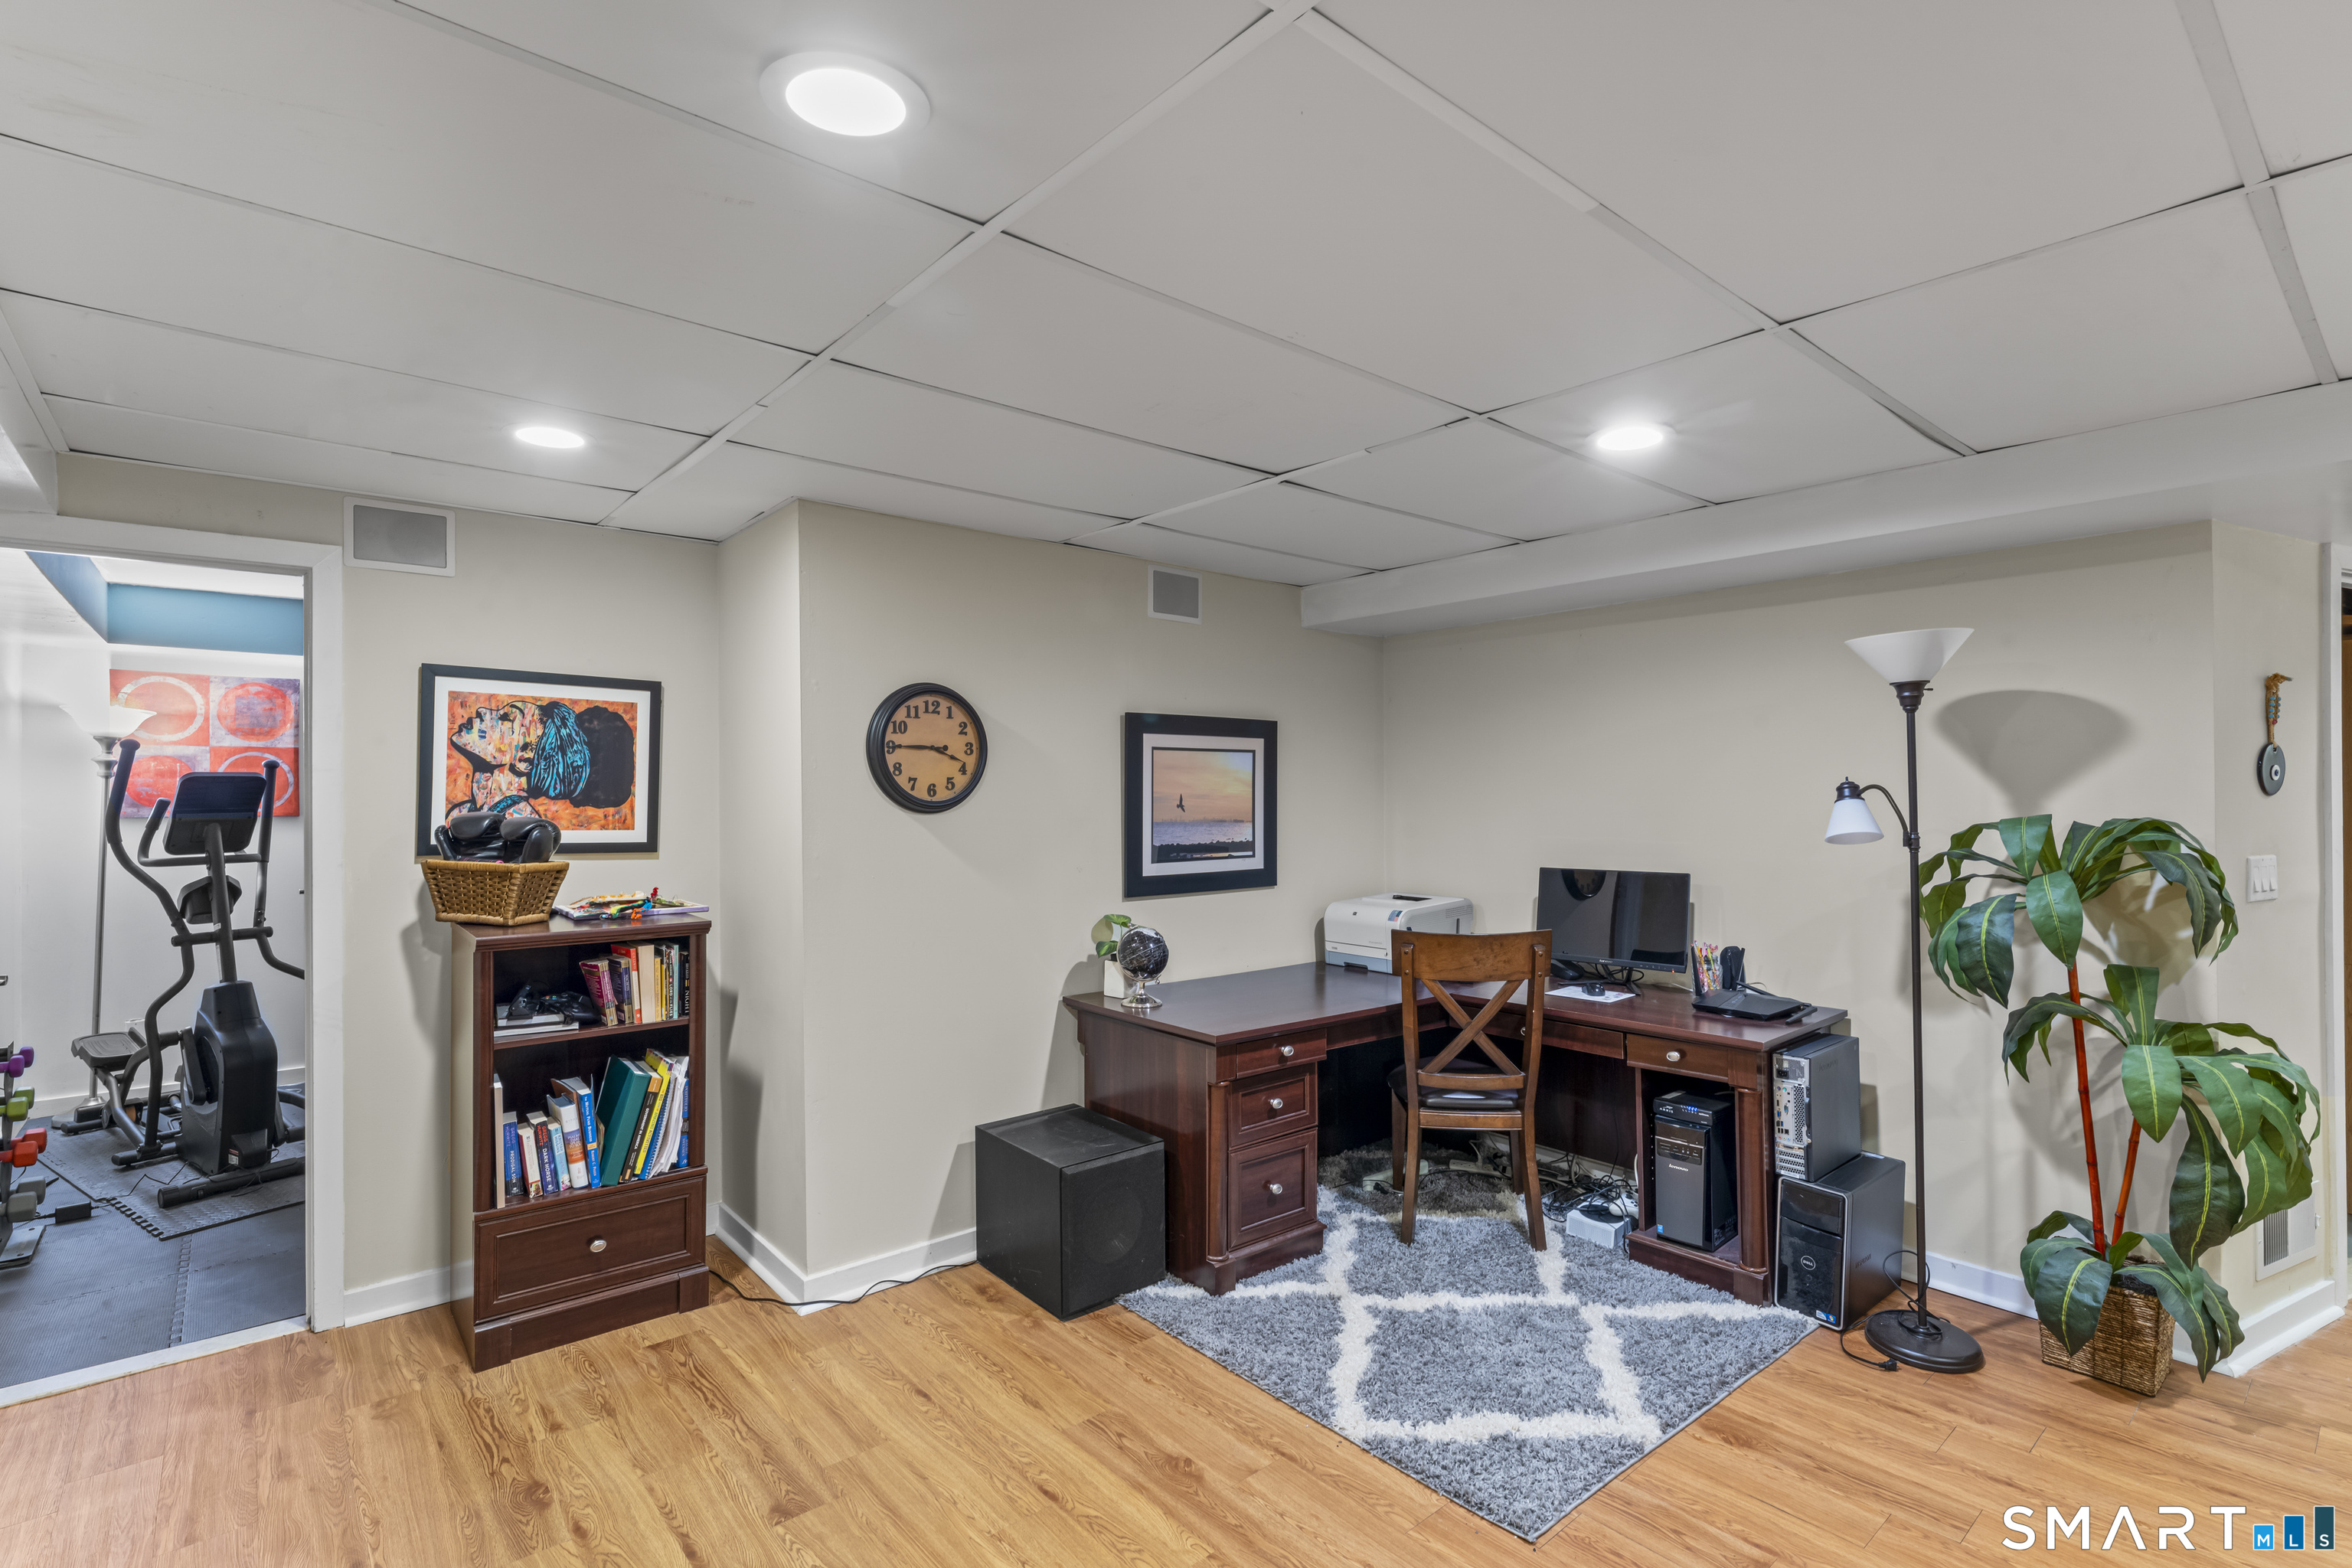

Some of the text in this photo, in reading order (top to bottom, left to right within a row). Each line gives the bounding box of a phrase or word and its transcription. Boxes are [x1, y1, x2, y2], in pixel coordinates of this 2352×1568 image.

[905, 705, 920, 719] 11
[923, 700, 940, 715] 12
[946, 706, 954, 719] 1
[890, 720, 907, 734] 10
[958, 722, 968, 736] 2
[886, 740, 896, 754] 9
[964, 742, 974, 756] 3
[893, 763, 902, 776] 8
[959, 762, 967, 775] 4
[908, 776, 917, 791] 7
[927, 783, 937, 797] 6
[946, 777, 956, 790] 5
[640, 1107, 650, 1130] GOVERNMENT
[1668, 1163, 1689, 1172] lenovo
